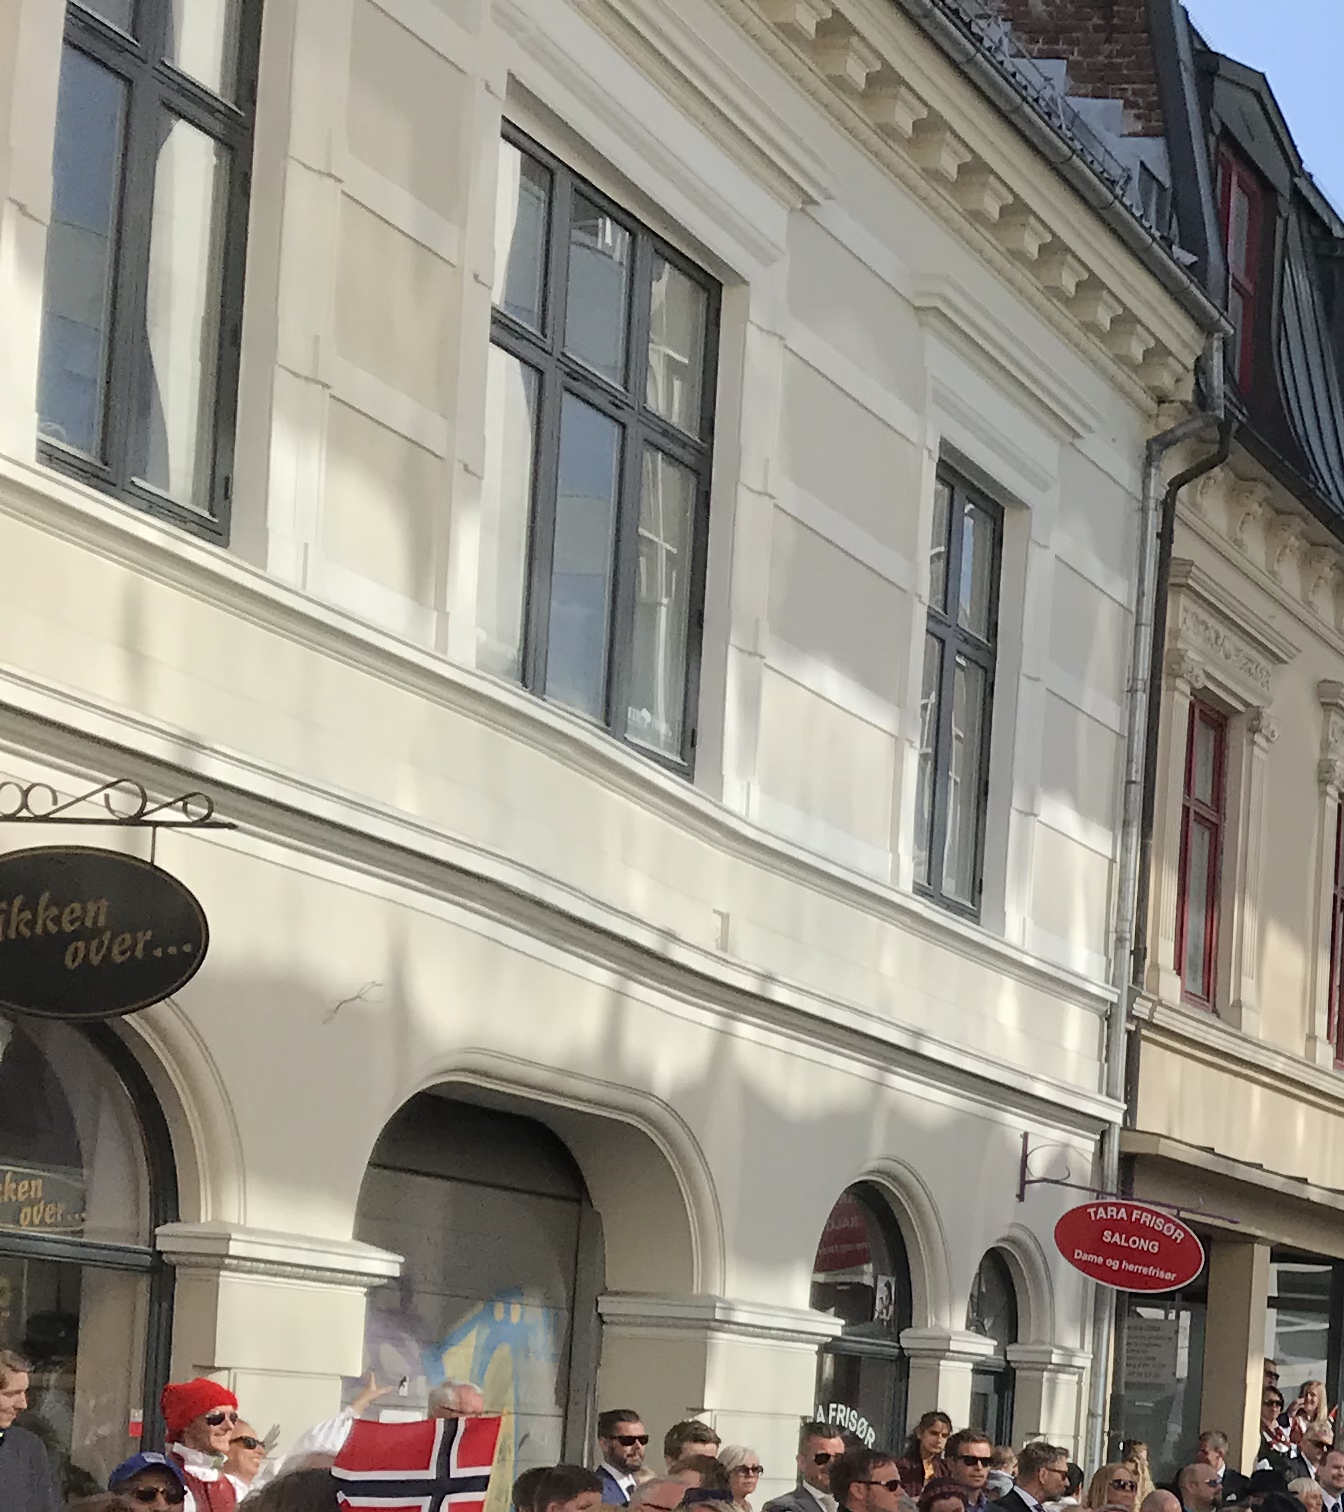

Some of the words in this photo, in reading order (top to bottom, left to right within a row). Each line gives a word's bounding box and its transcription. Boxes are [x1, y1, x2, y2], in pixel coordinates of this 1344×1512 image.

[1087, 1206, 1128, 1221] TARA
[1131, 1209, 1186, 1243] FRISØR
[1102, 1230, 1160, 1254] SALONG
[1074, 1249, 1104, 1265] Dame
[1106, 1258, 1119, 1271] og
[1122, 1260, 1177, 1282] herrefrisør
[828, 1403, 876, 1449] FRISØR
